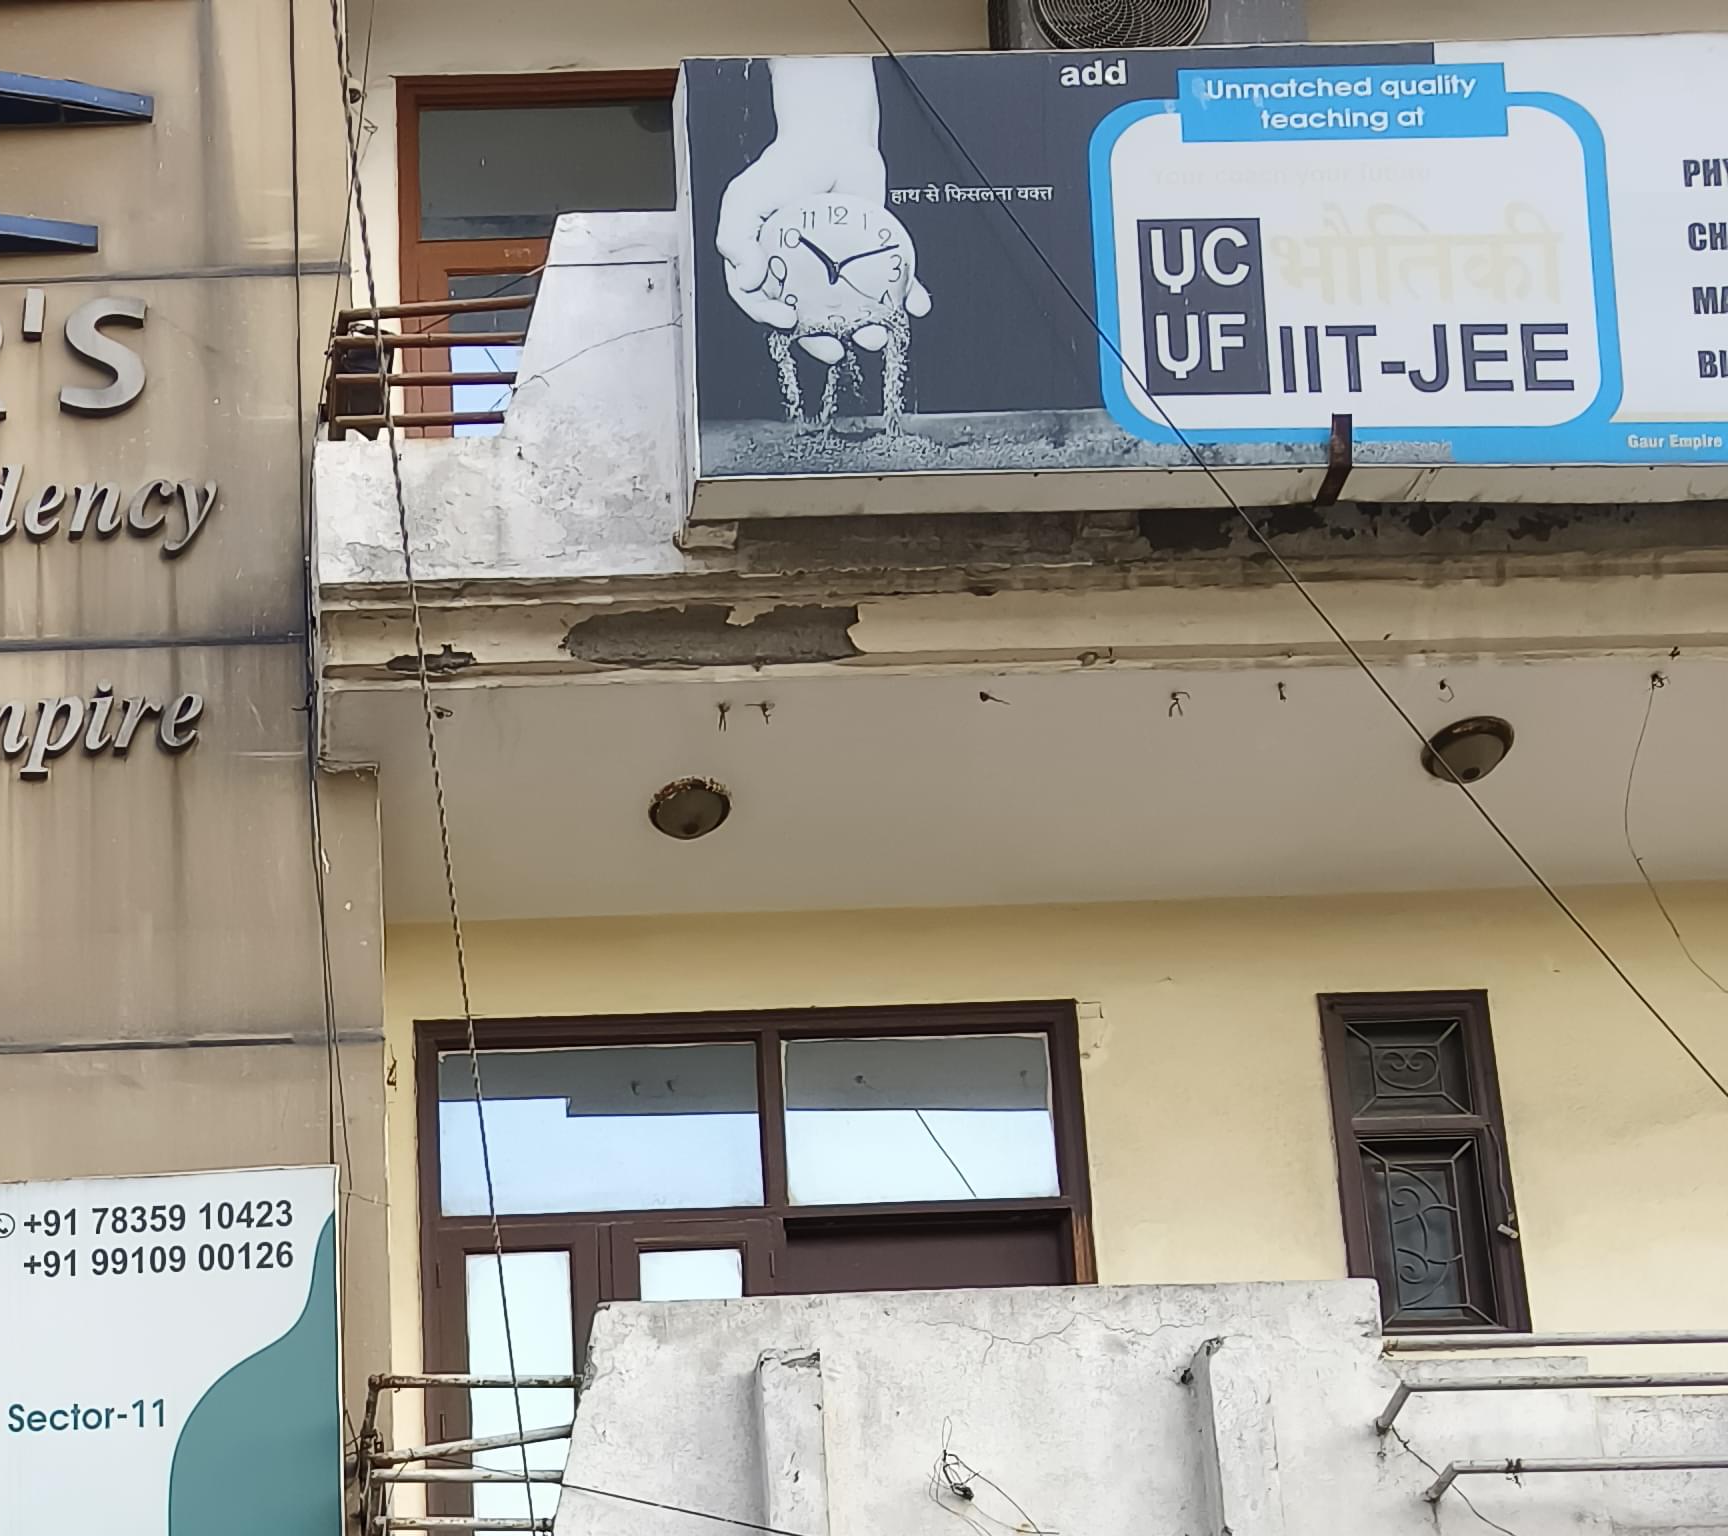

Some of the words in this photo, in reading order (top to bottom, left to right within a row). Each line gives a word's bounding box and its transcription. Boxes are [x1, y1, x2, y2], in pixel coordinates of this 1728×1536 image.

[1061, 60, 1126, 85] add
[1202, 78, 1371, 102] Unmatched
[1381, 75, 1475, 99] quality
[1261, 109, 1388, 131] teaching
[1397, 107, 1423, 126] at
[890, 188, 919, 203] हाथ
[1279, 323, 1574, 393] IIT-JEE
[1628, 435, 1664, 448] Gaur
[1670, 434, 1722, 449] Empire
[24, 1209, 75, 1236] +91
[92, 1205, 185, 1234] 78359
[200, 1200, 292, 1229] 10423
[8, 1399, 163, 1432] Sector-11
